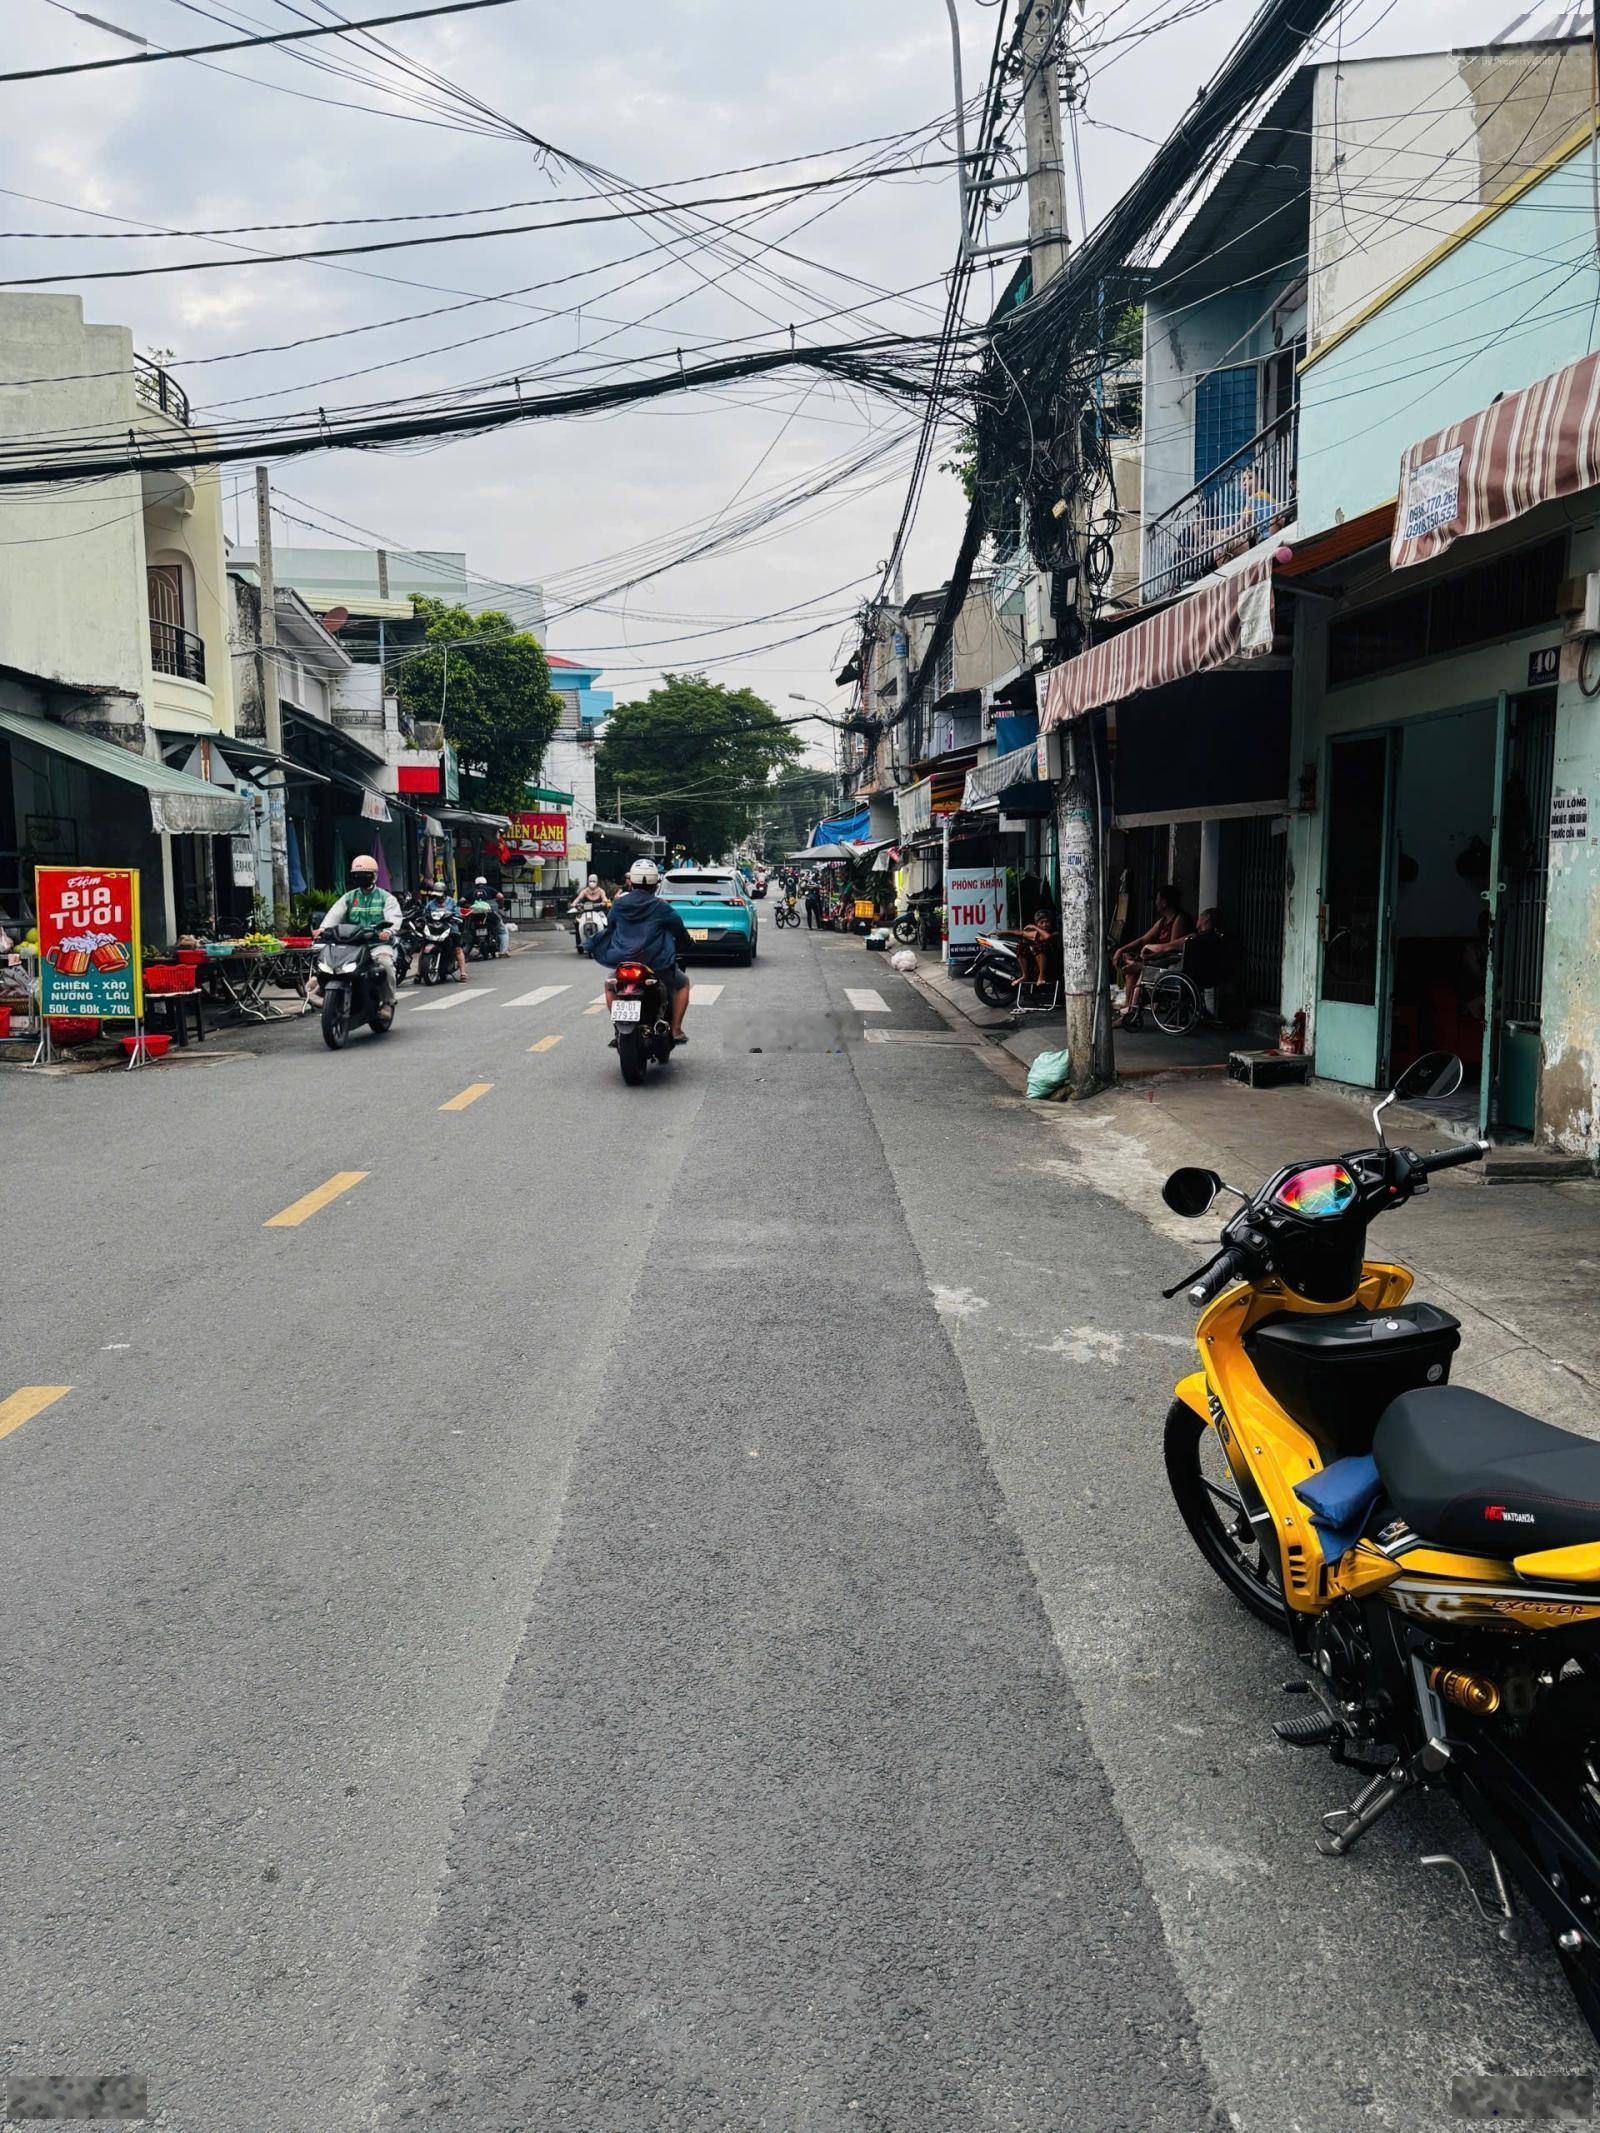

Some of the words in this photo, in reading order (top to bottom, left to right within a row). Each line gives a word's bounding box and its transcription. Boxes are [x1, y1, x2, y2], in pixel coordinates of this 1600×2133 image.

[1532, 650, 1556, 673] 40
[1553, 800, 1566, 809] VUI
[1567, 797, 1587, 808] LÒNG
[532, 821, 565, 840] LÀNH
[67, 876, 101, 888] Tiệm
[951, 878, 978, 890] PHÒNG
[61, 887, 111, 909] BIA
[50, 904, 122, 930] TƯƠI
[951, 899, 986, 926] THÚ
[993, 904, 1004, 924] Y
[49, 1004, 69, 1014] 50k
[80, 1004, 100, 1014] 60k
[110, 1004, 131, 1014] 70k
